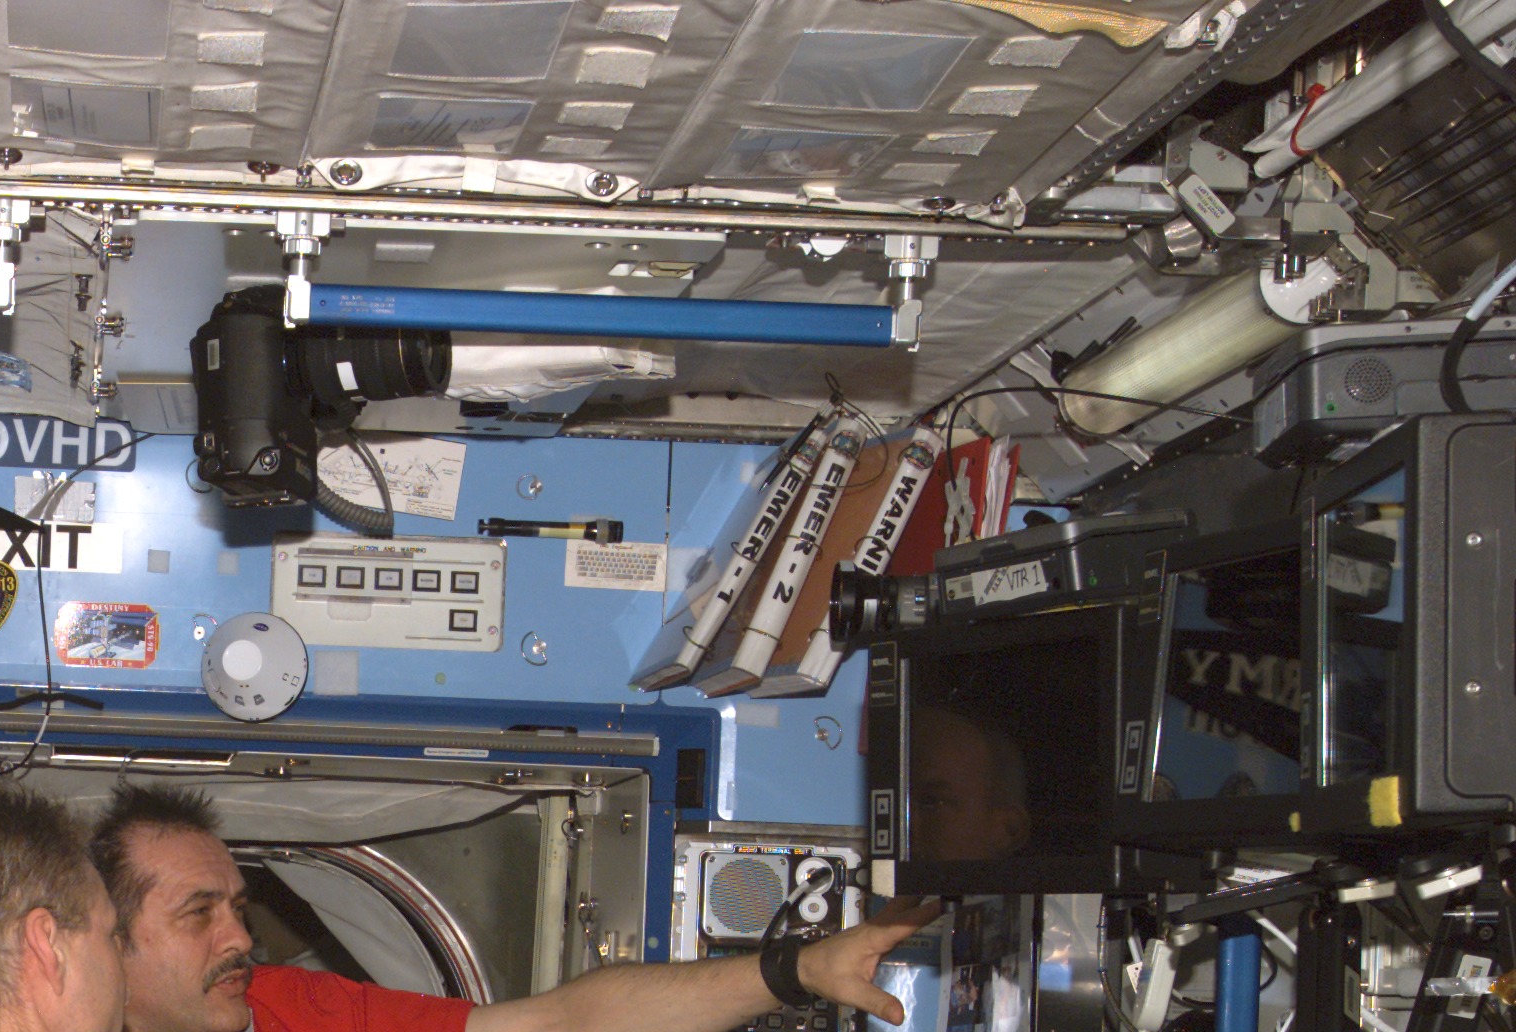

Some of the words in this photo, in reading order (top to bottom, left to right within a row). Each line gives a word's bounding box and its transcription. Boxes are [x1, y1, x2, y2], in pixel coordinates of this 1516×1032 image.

[740, 469, 805, 561] EMER
[793, 462, 848, 556] EMER
[0, 576, 15, 591] 13
[1006, 567, 1029, 591] VTR
[773, 581, 793, 604] 2
[91, 603, 130, 612] DESTINY
